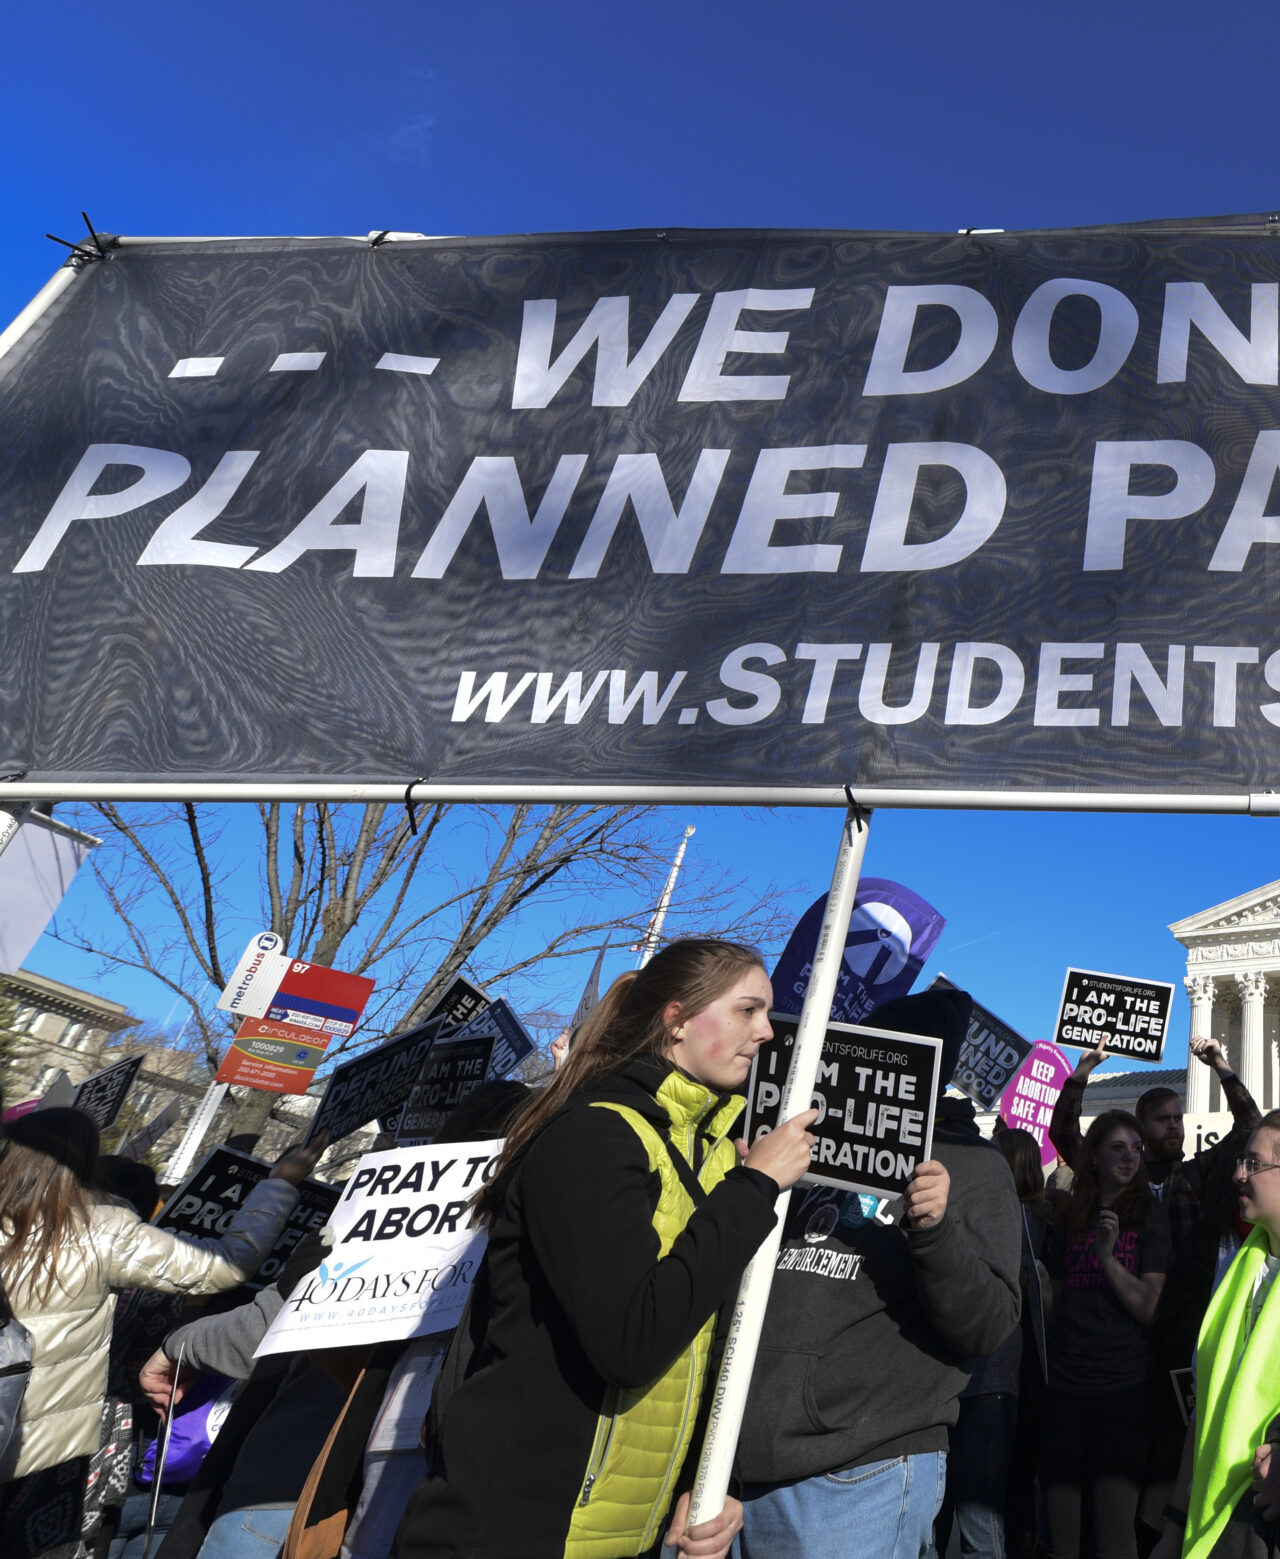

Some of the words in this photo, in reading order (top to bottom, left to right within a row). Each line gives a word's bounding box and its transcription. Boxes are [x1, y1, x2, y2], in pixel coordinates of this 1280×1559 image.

[512, 288, 816, 410] WE
[12, 441, 1007, 580] PLANNED
[230, 952, 265, 1008] metrobus
[292, 962, 311, 974] 97
[1072, 987, 1078, 1000] I
[1085, 990, 1115, 1006] AM
[1124, 996, 1161, 1015] THE
[1089, 980, 1156, 997] STUDENTSFORLIFE.ORG
[1062, 1002, 1163, 1036] PRO-LIFE
[251, 1040, 285, 1054] 1000829
[822, 1040, 908, 1066] ENTSFORLIFE.ORG
[966, 1018, 1020, 1069] UND
[1061, 1025, 1158, 1054] GENERATION
[428, 1061, 450, 1080] AM
[456, 1057, 484, 1077] THE
[768, 1050, 778, 1075] I
[814, 1059, 840, 1087] M
[854, 1066, 918, 1101] THE
[1031, 1058, 1055, 1083] KEEP
[403, 1110, 452, 1132] GENERA
[755, 1081, 925, 1147] PO-LIFE
[1011, 1095, 1036, 1122] SAFE
[1036, 1104, 1054, 1128] AN
[344, 1158, 458, 1202] PRAY
[341, 1200, 479, 1244] ABOR
[776, 1246, 866, 1281] ENFORCEMENT
[720, 1336, 737, 1382] SCH40
[711, 1386, 726, 1420] DWV
[702, 1421, 719, 1463] PVC1120
[698, 1464, 709, 1481] 370
[695, 1482, 705, 1499] PSI
